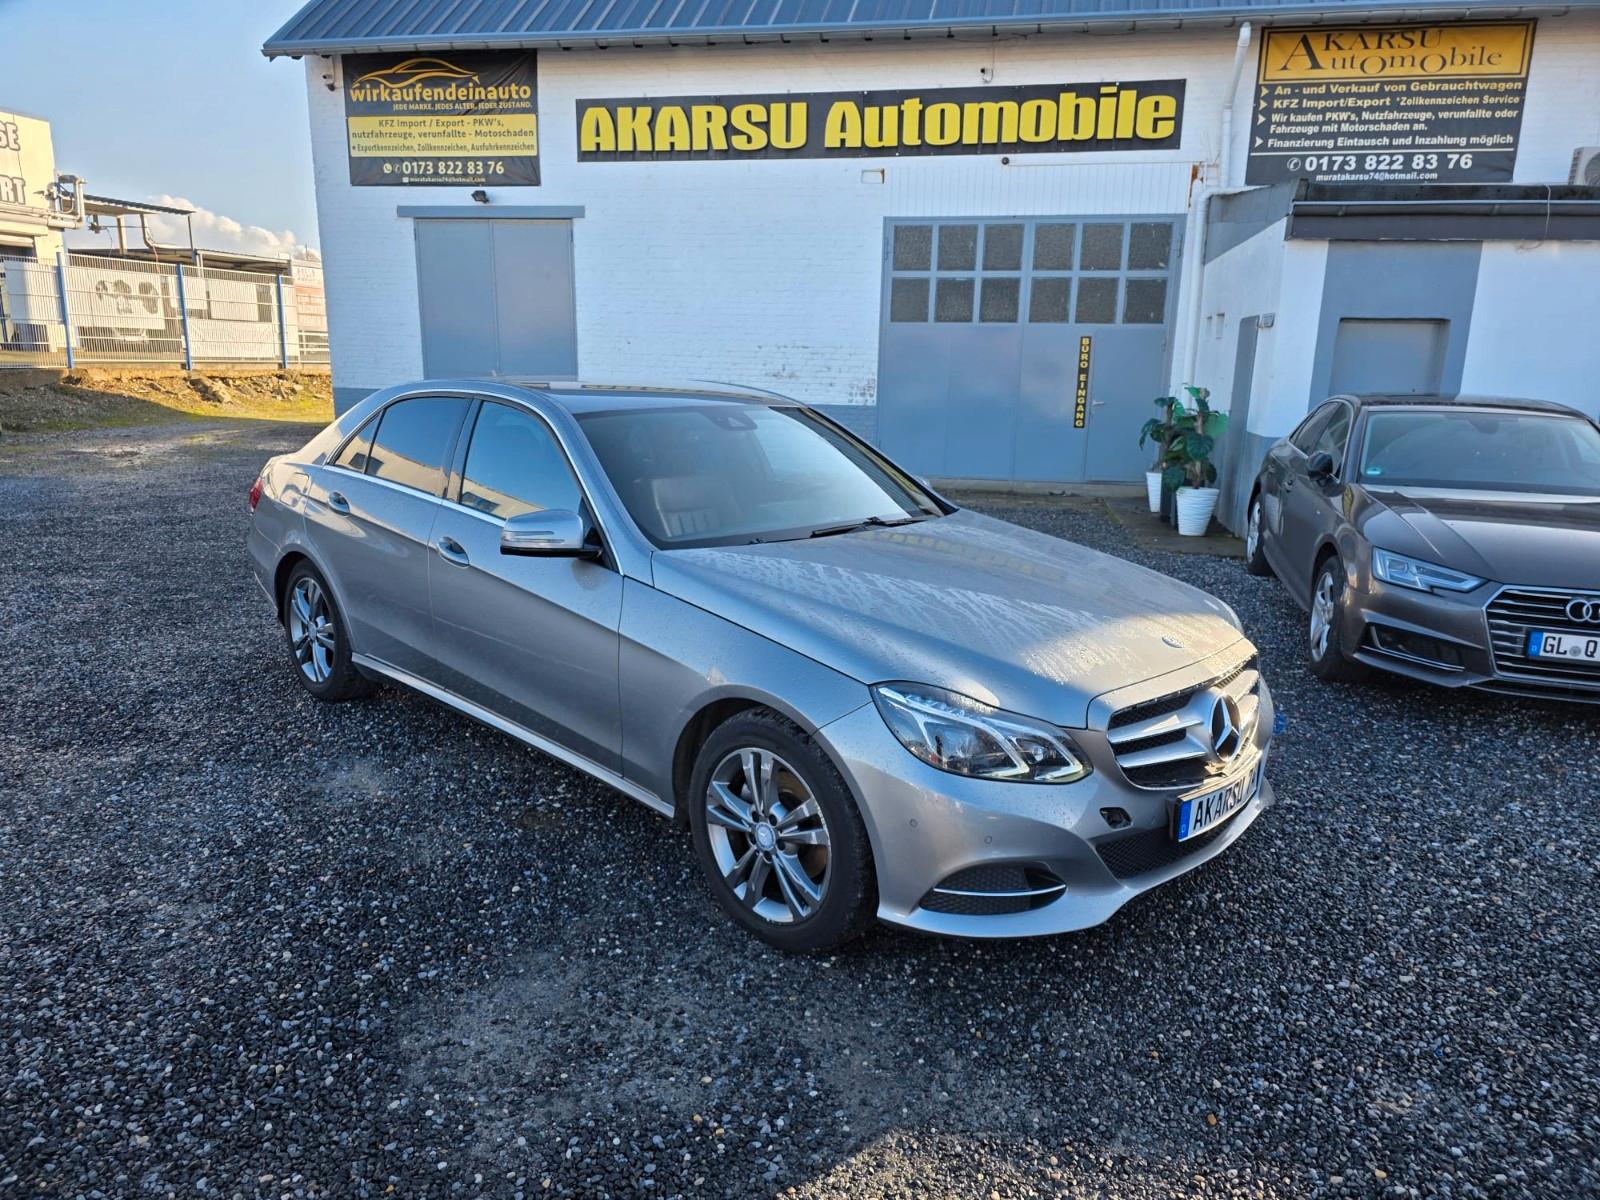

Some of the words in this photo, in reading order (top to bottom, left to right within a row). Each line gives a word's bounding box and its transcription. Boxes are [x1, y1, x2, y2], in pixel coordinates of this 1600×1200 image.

[1277, 29, 1445, 71] AKARSU
[350, 83, 532, 102] wirkaufendeinauto
[1274, 86, 1291, 95] An
[1302, 84, 1326, 94] und
[1330, 83, 1380, 94] Verkauf
[1383, 84, 1407, 92] von
[1410, 80, 1523, 92] Gebrauchtwagen
[1272, 98, 1300, 109] KFZ
[1302, 97, 1391, 109] Import/Export
[1482, 94, 1520, 104] Service
[378, 119, 396, 128] KFZ
[397, 119, 426, 129] Import
[435, 119, 465, 129] Export
[472, 118, 505, 127] PKW's,
[580, 102, 808, 151] AKARSU
[824, 86, 1177, 148] Automobile
[1271, 113, 1289, 123] Wir
[1290, 112, 1323, 122] kaufen
[1325, 112, 1359, 122] PKW's,
[1361, 110, 1436, 121] Nutzfahrzeuge,
[1438, 109, 1492, 119] verunfallte
[1494, 109, 1519, 118] oder
[351, 130, 416, 140] nutzfahrzeuge,
[417, 129, 466, 139] verunfallte
[474, 128, 535, 138] Motoschaden
[1270, 124, 1320, 135] Fahrzeuge
[1321, 123, 1339, 132] mit
[1340, 122, 1410, 132] Motorschaden
[1412, 122, 1428, 131] an.
[1267, 138, 1335, 149] Finanzierung
[1336, 136, 1390, 147] Eintausch
[1392, 136, 1412, 145] und
[1415, 135, 1467, 146] Inzahlung
[1470, 134, 1514, 146] möglich
[402, 161, 434, 174] 0173
[438, 161, 463, 174] 822
[467, 161, 484, 174] 83
[487, 161, 505, 174] 76
[1305, 155, 1357, 171] 0173
[1364, 154, 1404, 170] 822
[1411, 153, 1438, 170] 83
[1447, 153, 1473, 169] 76
[1316, 172, 1438, 182] muratakarsu74@hotmail.com
[1075, 374, 1087, 427] EINGANG
[1543, 636, 1567, 656] GL
[1585, 639, 1598, 658] Q
[1193, 776, 1246, 830] AKARSU
